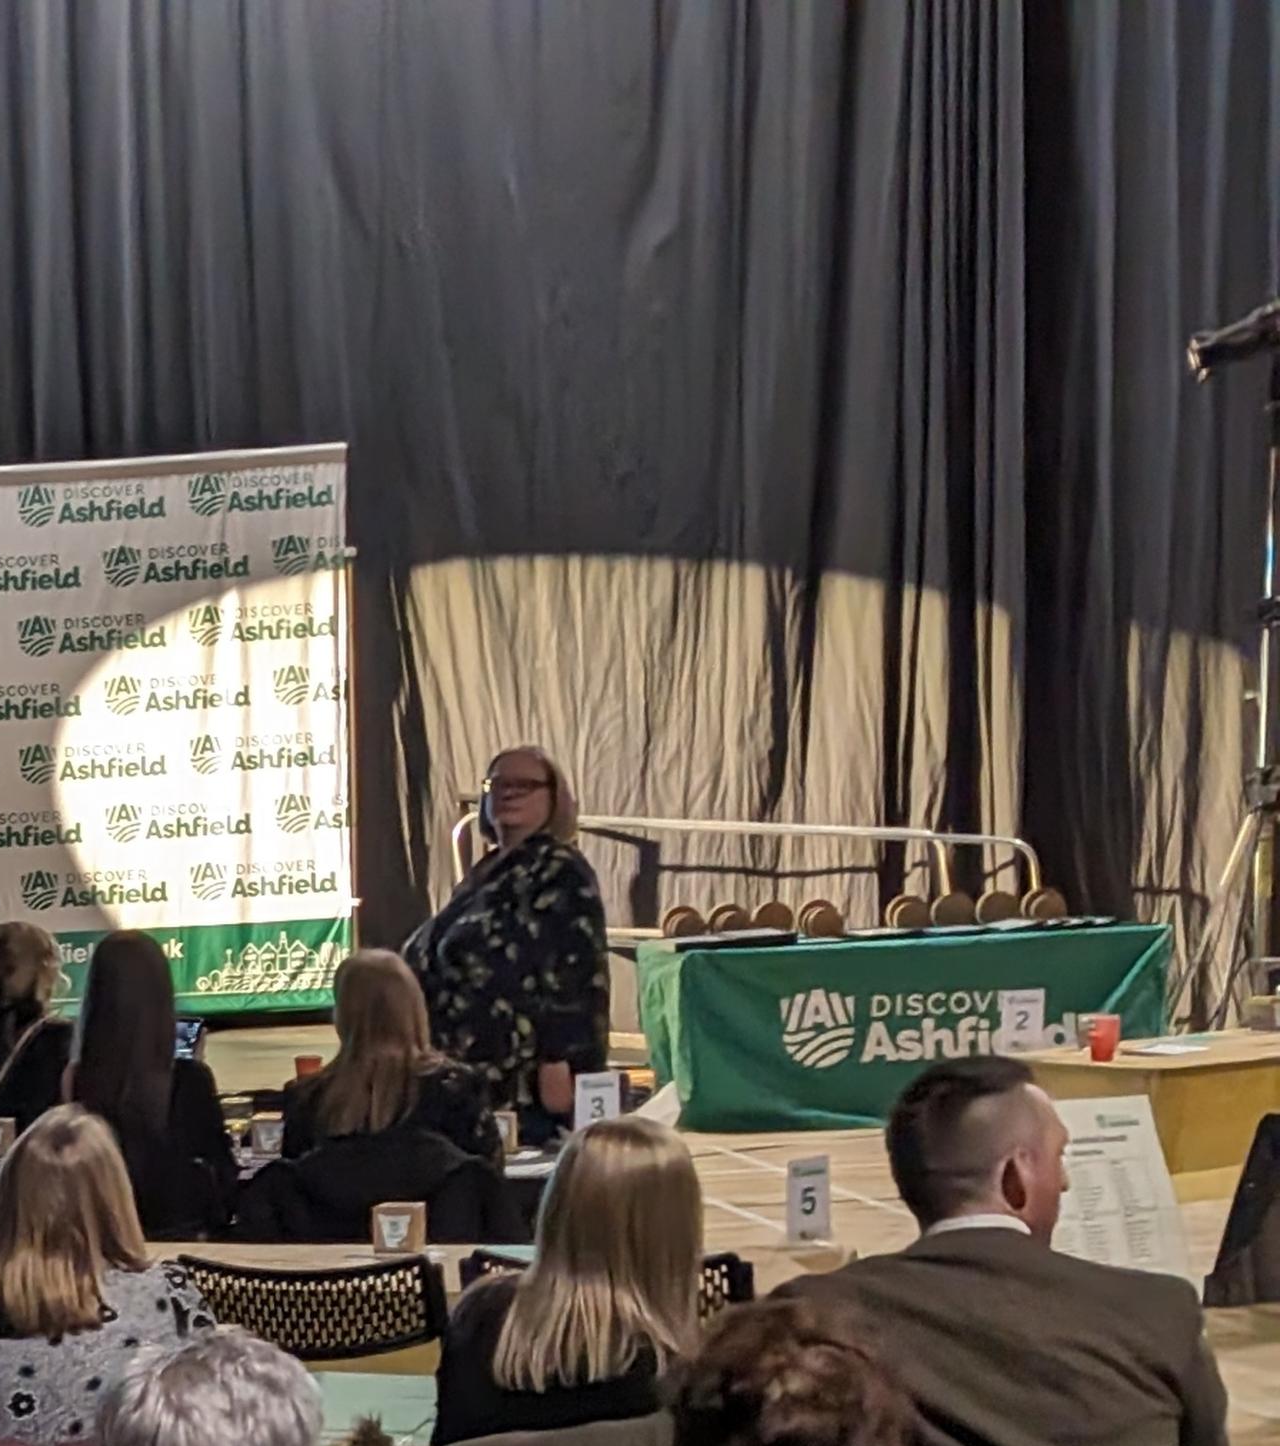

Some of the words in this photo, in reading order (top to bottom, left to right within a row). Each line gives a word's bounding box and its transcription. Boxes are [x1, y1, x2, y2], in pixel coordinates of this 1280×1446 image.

[63, 484, 145, 499] DISCOVER
[231, 472, 314, 488] DISCOVER
[58, 496, 166, 524] Ashfield
[228, 485, 334, 511] Ashfield
[148, 543, 229, 559] DISCOVER
[143, 556, 250, 584] Ashfield
[63, 613, 145, 630] DISCOVER
[231, 615, 336, 642] Ashfield
[58, 626, 166, 654] Ashfield
[145, 684, 251, 712] Ashfield
[64, 743, 146, 758] DISCOVER
[234, 732, 314, 748] DISCOVER
[59, 755, 167, 781] Ashfield
[231, 745, 336, 770] Ashfield
[145, 813, 252, 839] Ashfield
[65, 869, 147, 884] DISCOVER
[235, 859, 316, 875] DISCOVER
[60, 882, 168, 908] Ashfield
[231, 872, 337, 898] Ashfield
[870, 989, 1003, 1018] DISCOV
[1015, 1010, 1030, 1031] 2
[859, 1012, 1080, 1063] Ashfid
[590, 1095, 606, 1119] 3
[800, 1186, 817, 1216] 5
